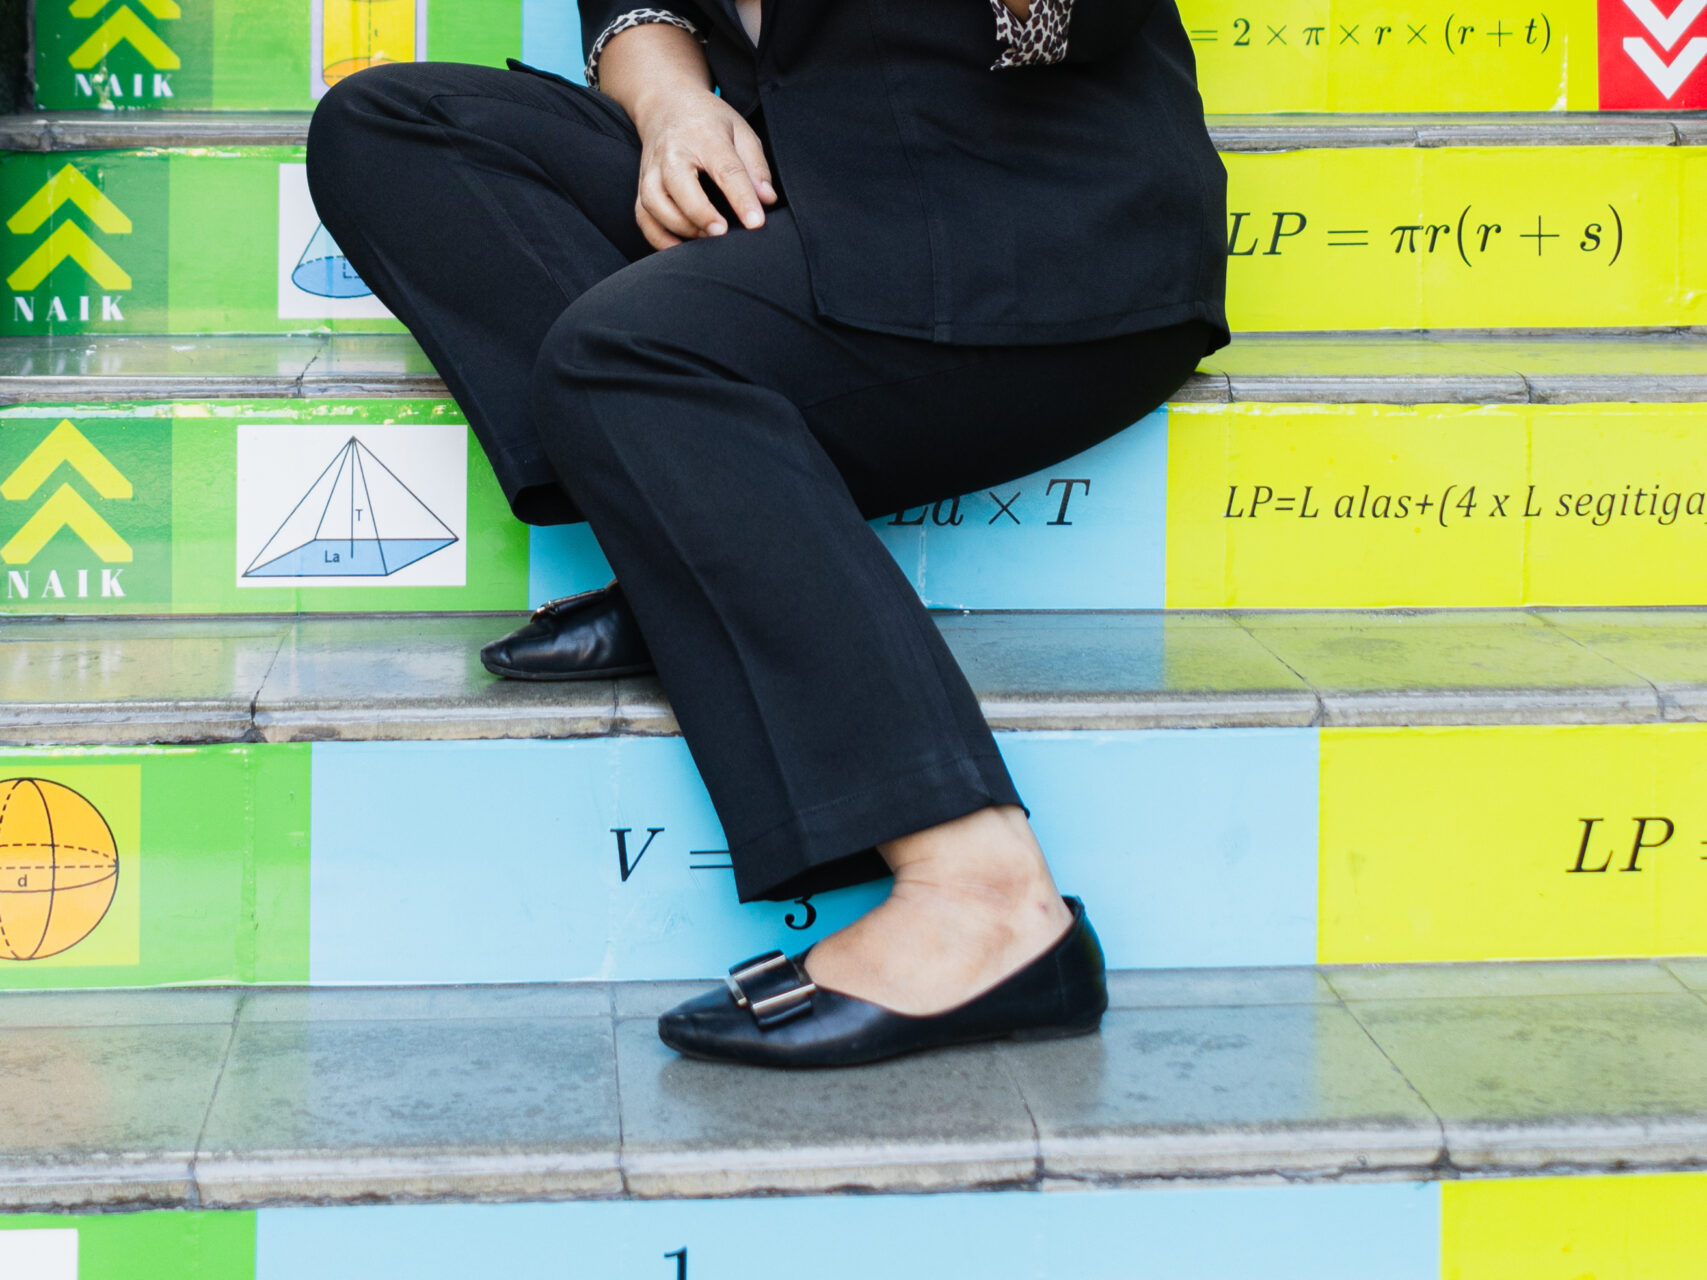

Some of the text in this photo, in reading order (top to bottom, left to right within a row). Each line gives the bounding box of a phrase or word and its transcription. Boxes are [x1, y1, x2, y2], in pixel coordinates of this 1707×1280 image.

[1232, 17, 1251, 47] 2
[1374, 25, 1392, 47] r
[74, 72, 175, 98] NAIK
[1226, 211, 1308, 257] LP
[13, 294, 126, 322] NAIK
[355, 508, 364, 521] T
[1044, 478, 1092, 527] T
[1488, 494, 1511, 518] x
[1522, 484, 1543, 518] L
[1555, 483, 1707, 527] segitiga
[324, 549, 341, 564] La
[6, 568, 127, 599] NAIK
[609, 827, 666, 883] V
[1564, 815, 1676, 874] LP
[17, 873, 28, 888] d
[783, 893, 817, 931] 3
